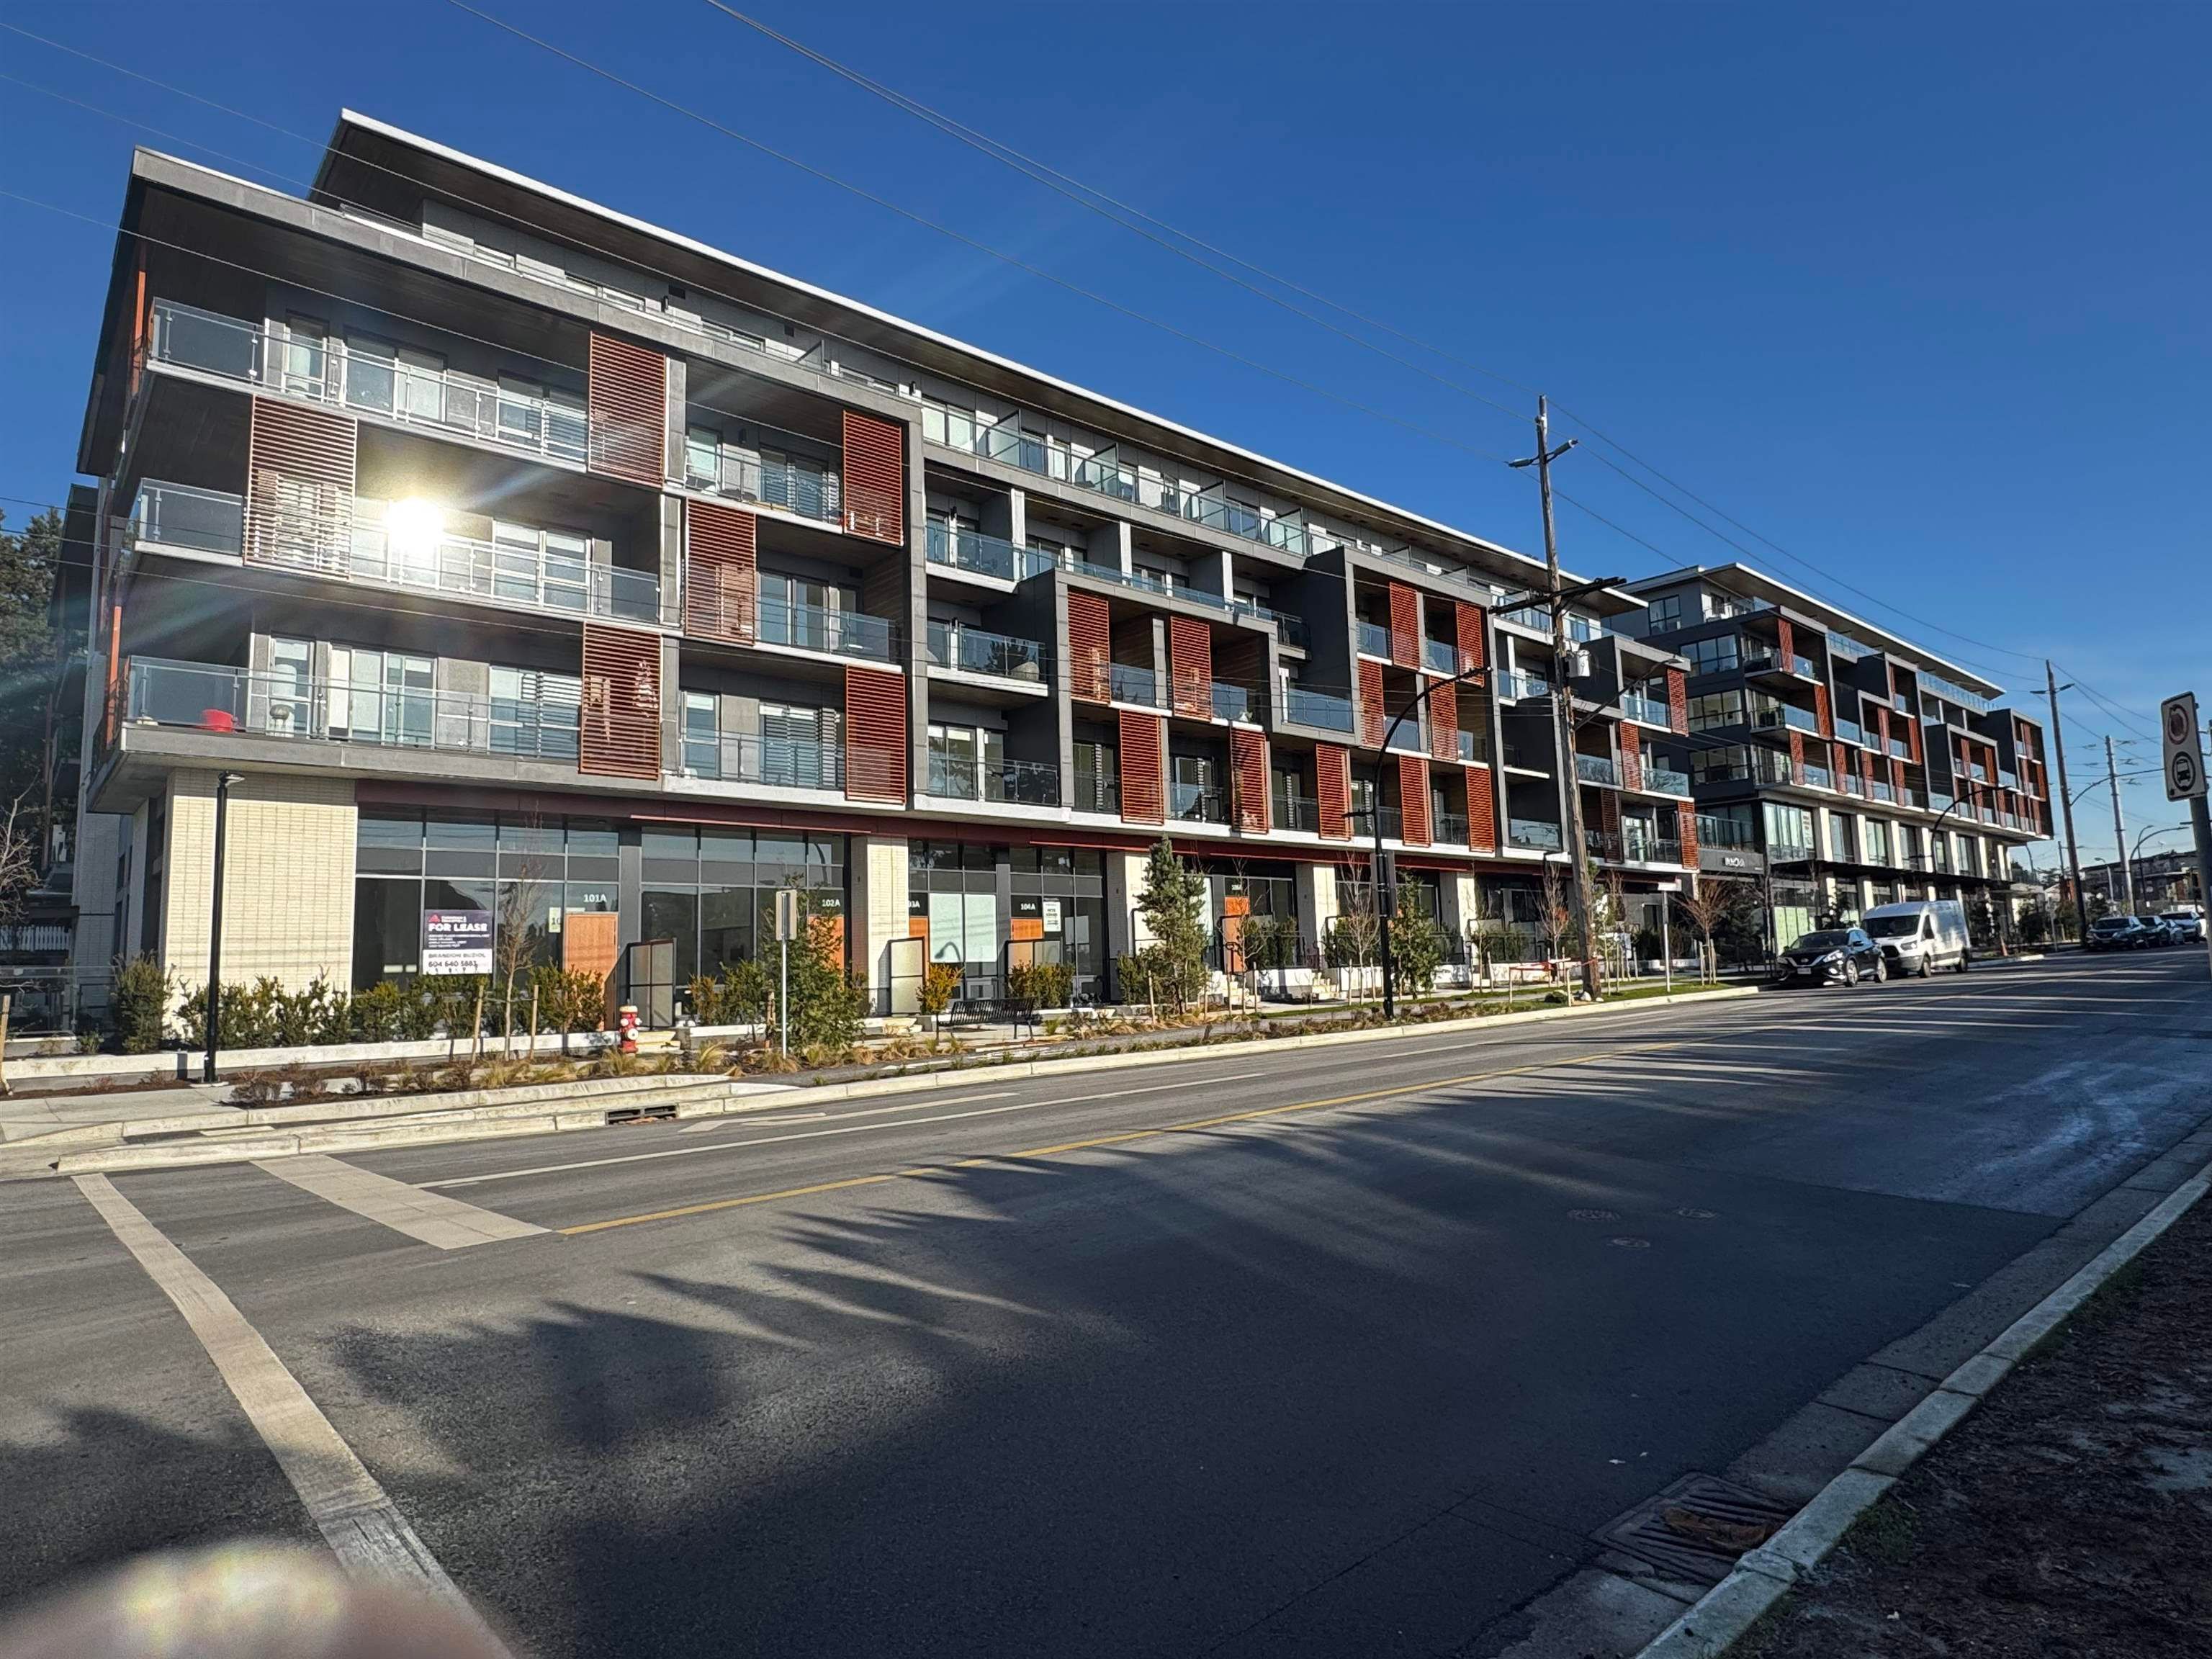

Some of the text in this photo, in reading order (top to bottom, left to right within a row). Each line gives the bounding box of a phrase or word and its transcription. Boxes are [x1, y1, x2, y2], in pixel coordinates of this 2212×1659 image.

[583, 894, 607, 902] 101A
[428, 923, 487, 932] FOR LEASE
